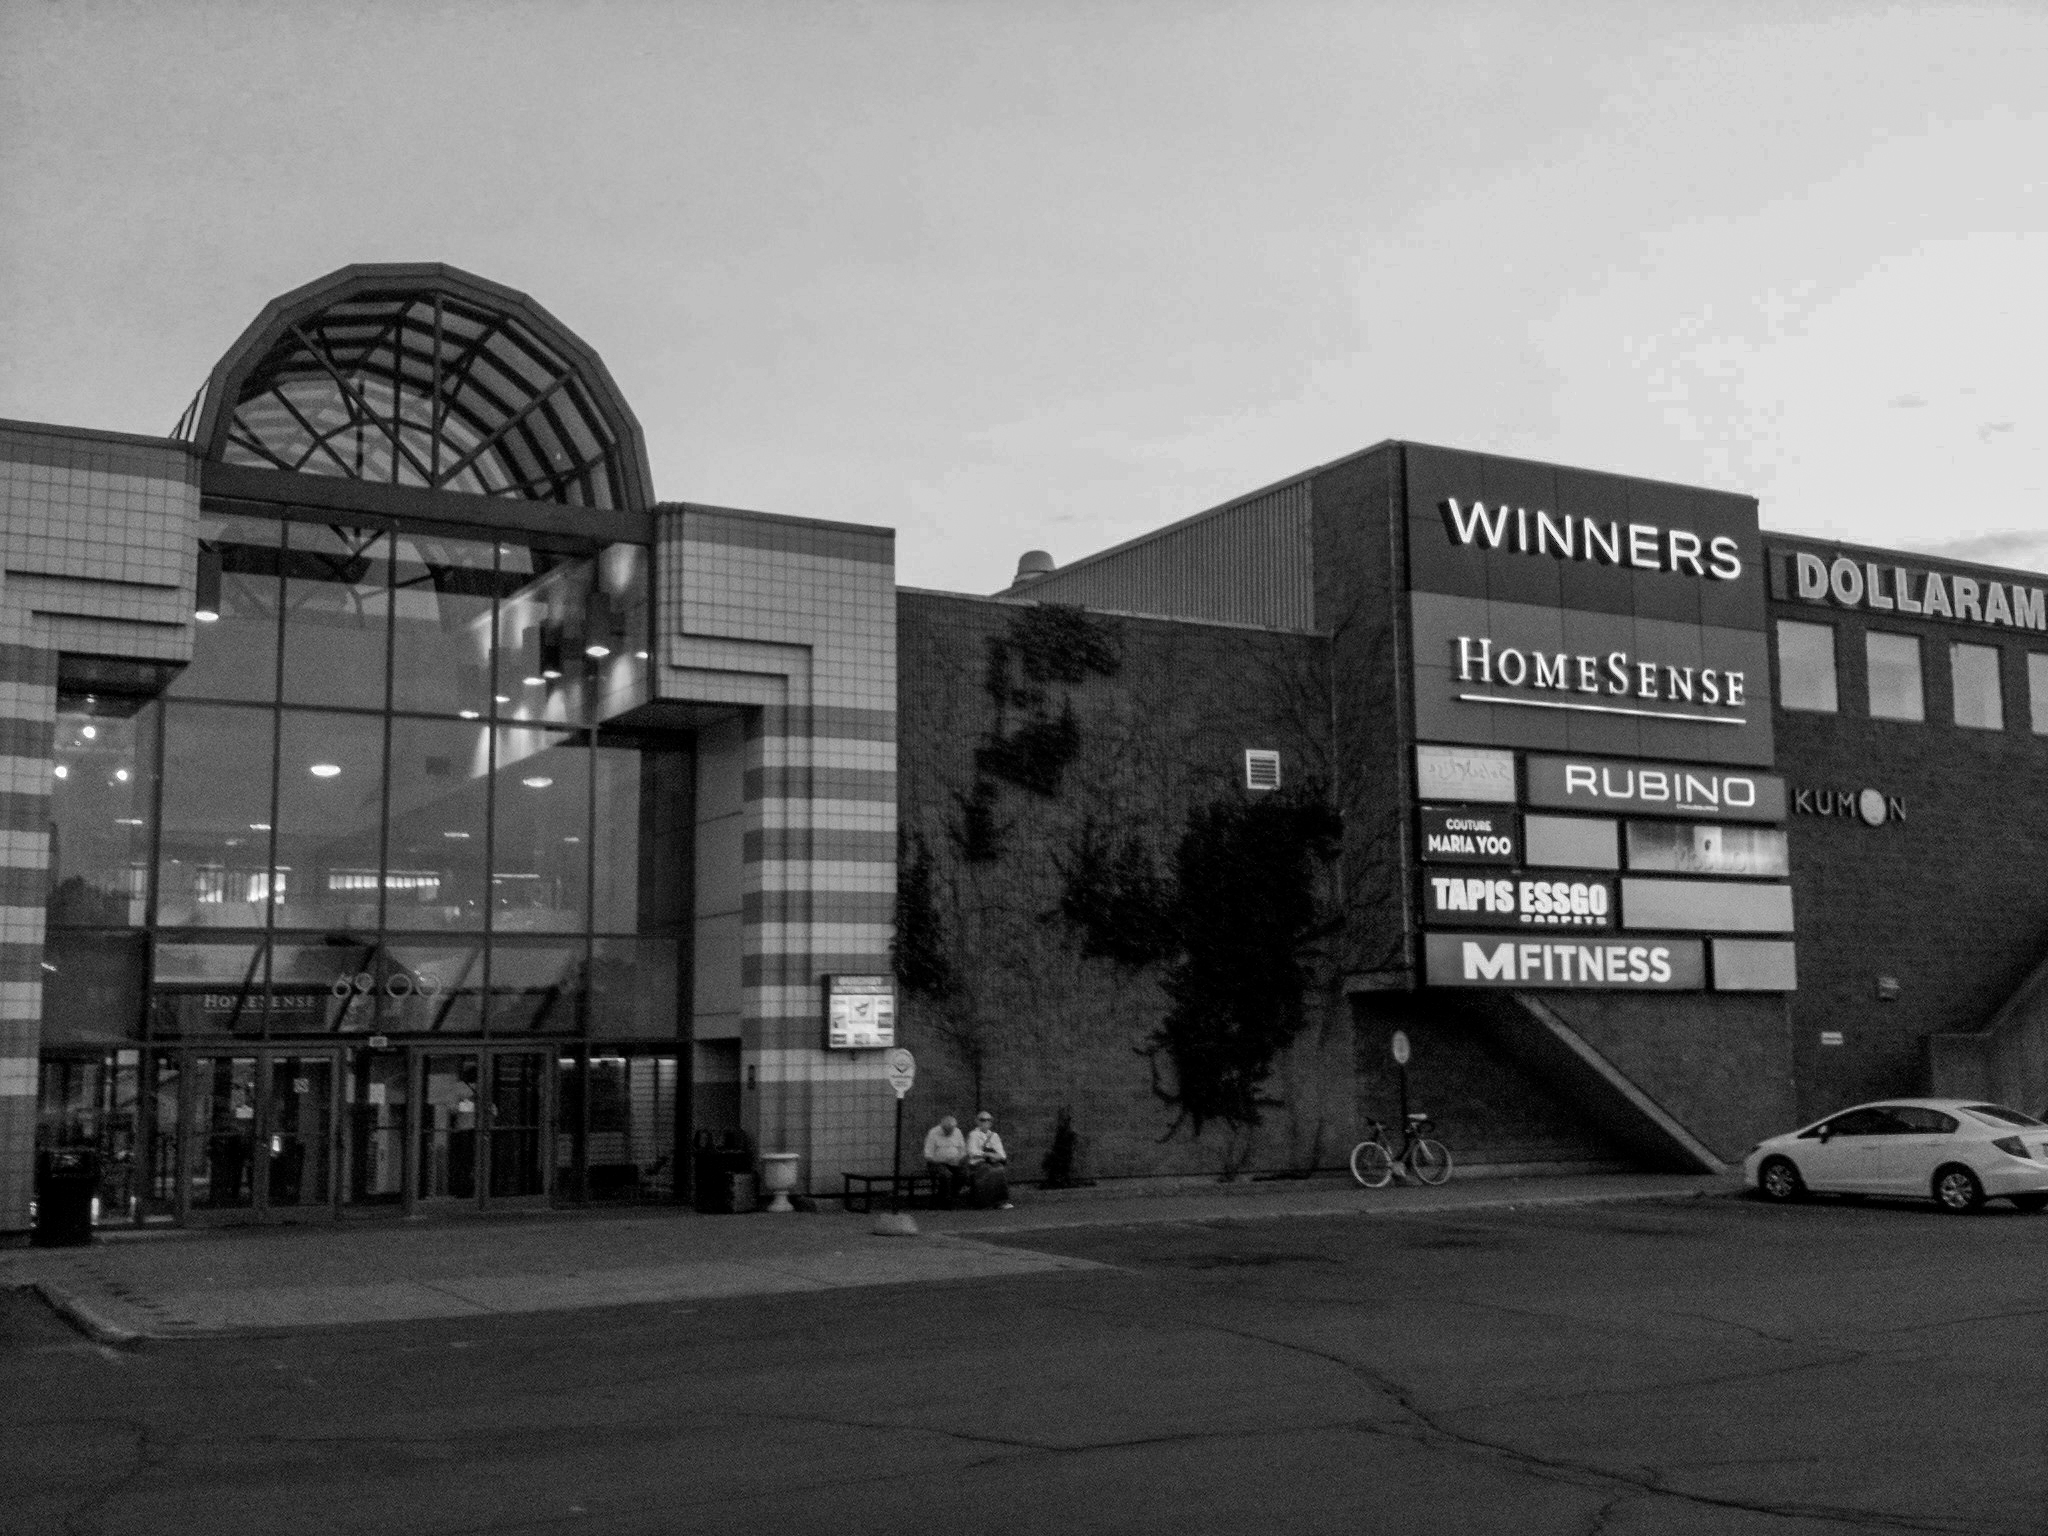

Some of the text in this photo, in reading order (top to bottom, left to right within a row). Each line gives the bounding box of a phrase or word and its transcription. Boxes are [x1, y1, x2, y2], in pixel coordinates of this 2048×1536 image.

[1449, 498, 1742, 580] WINNERS
[1796, 552, 2047, 631] DOLLARAM
[1565, 764, 1756, 807] RUBINO
[1446, 818, 1492, 832] COUTURE
[1795, 787, 1907, 827] KUMON
[1428, 834, 1512, 855] MARIA YOO
[1431, 877, 1608, 915] TAPIS ESSGO
